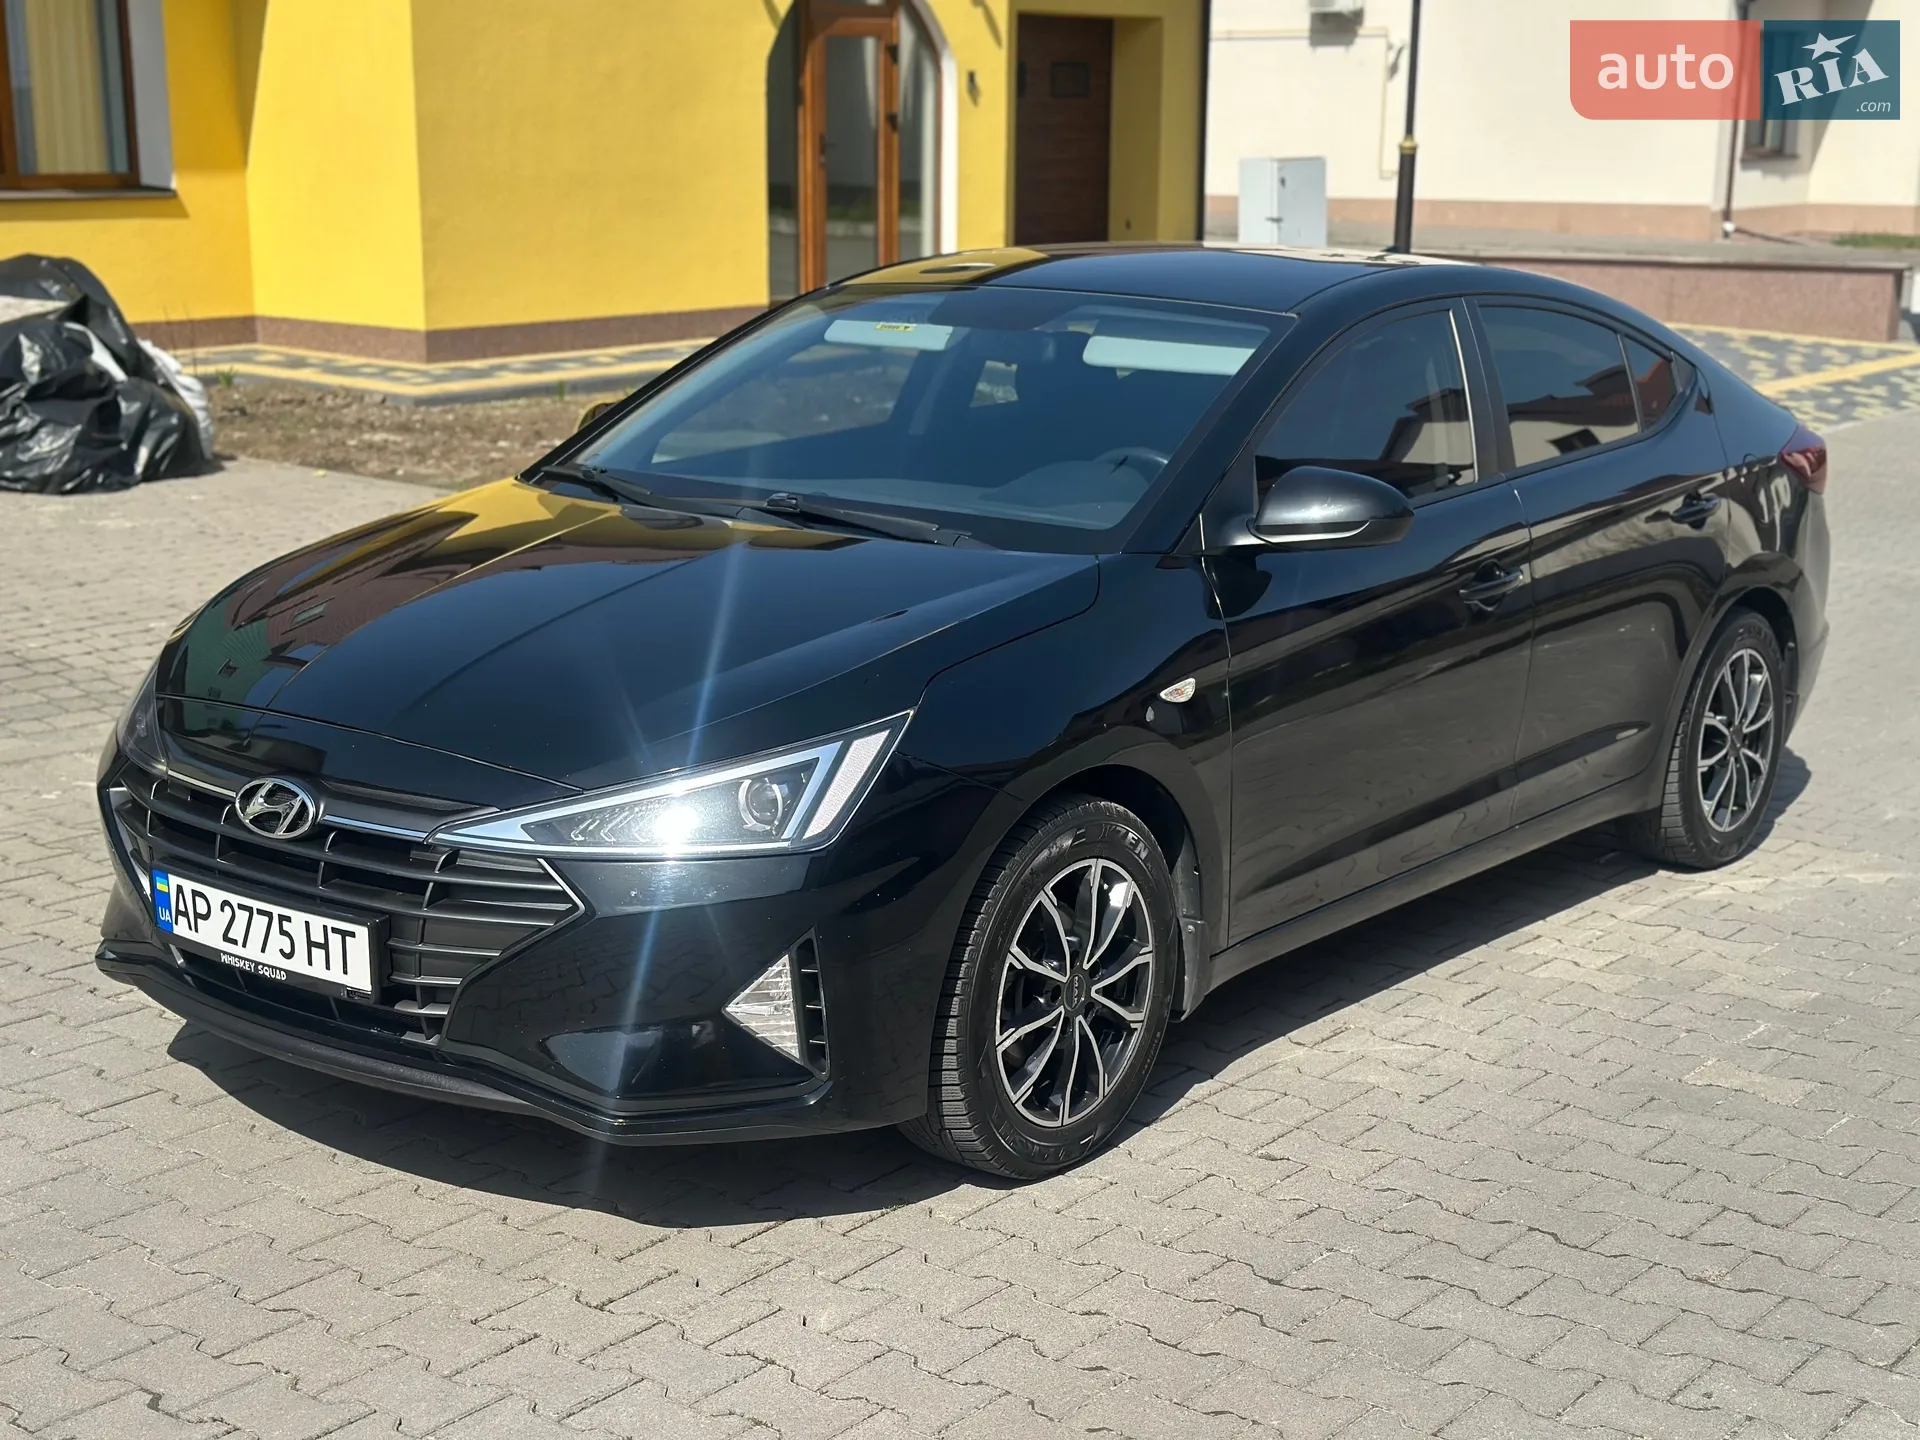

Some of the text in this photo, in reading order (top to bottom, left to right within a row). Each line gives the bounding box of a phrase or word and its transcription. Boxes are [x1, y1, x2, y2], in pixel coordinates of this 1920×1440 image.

[158, 906, 172, 924] UA
[174, 883, 356, 976] AP 2775 HT
[220, 952, 287, 981] WHISKEY SQUAD
